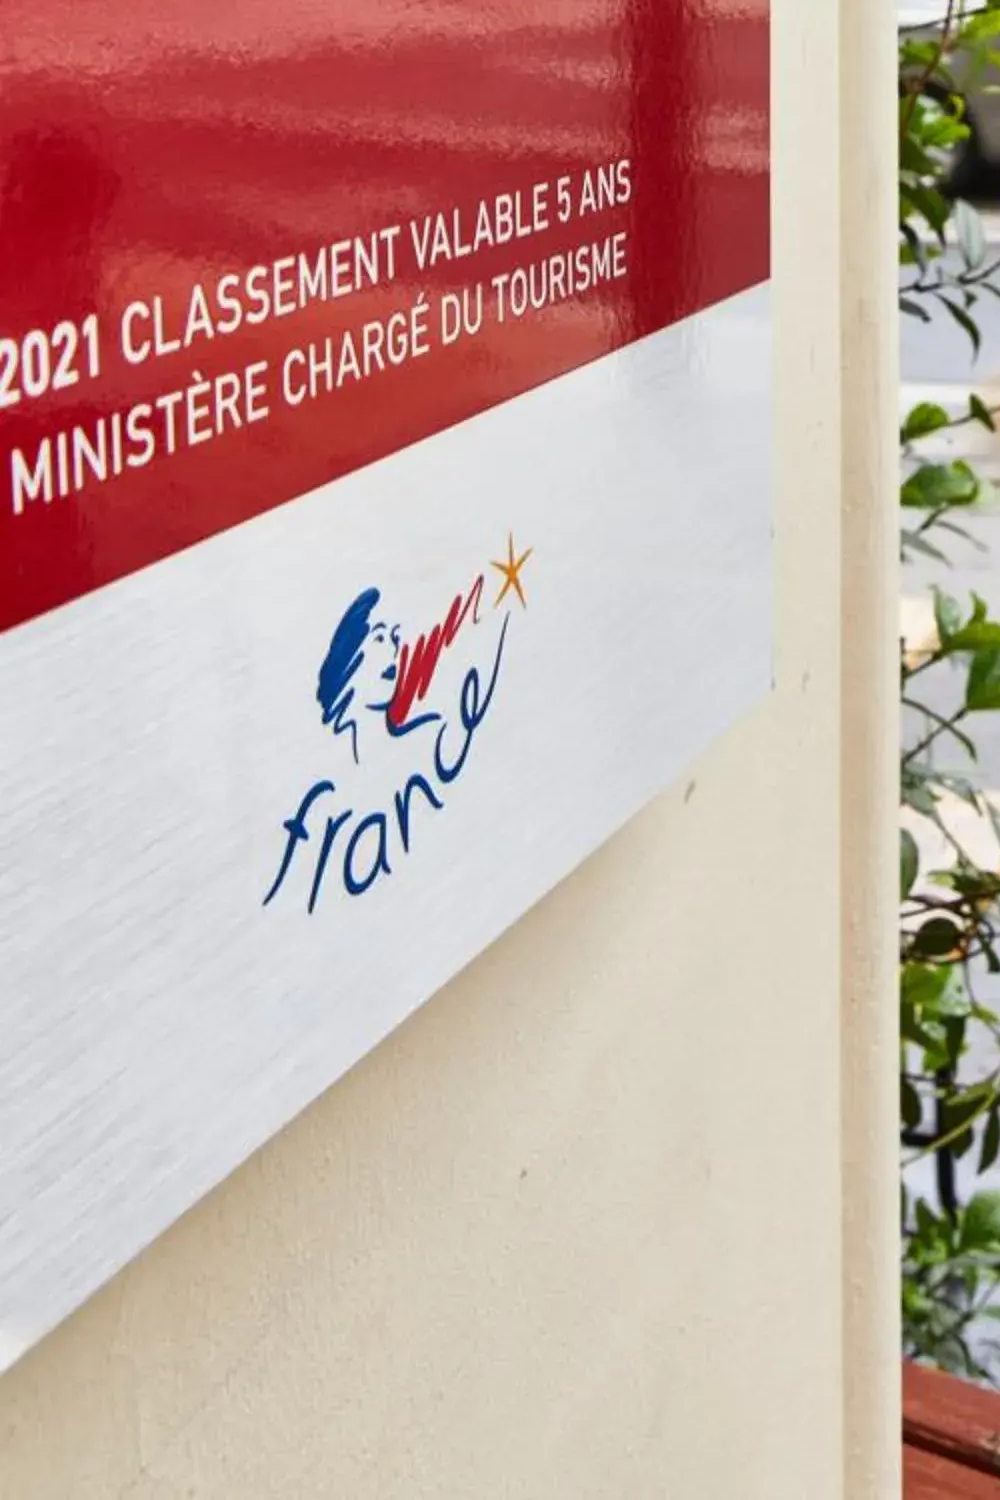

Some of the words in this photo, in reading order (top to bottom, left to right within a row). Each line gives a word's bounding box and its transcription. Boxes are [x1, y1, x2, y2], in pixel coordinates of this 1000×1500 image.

[0, 314, 100, 409] 2021
[120, 226, 401, 364] CLASSEMENT
[410, 181, 549, 269] VALABLE
[557, 176, 572, 223] 5
[578, 159, 632, 215] ANS
[10, 361, 269, 515] MINISTÈRE
[282, 284, 430, 404] CHARGÉ
[441, 283, 482, 345] DU
[491, 233, 627, 322] TOURISME
[262, 610, 512, 915] france
